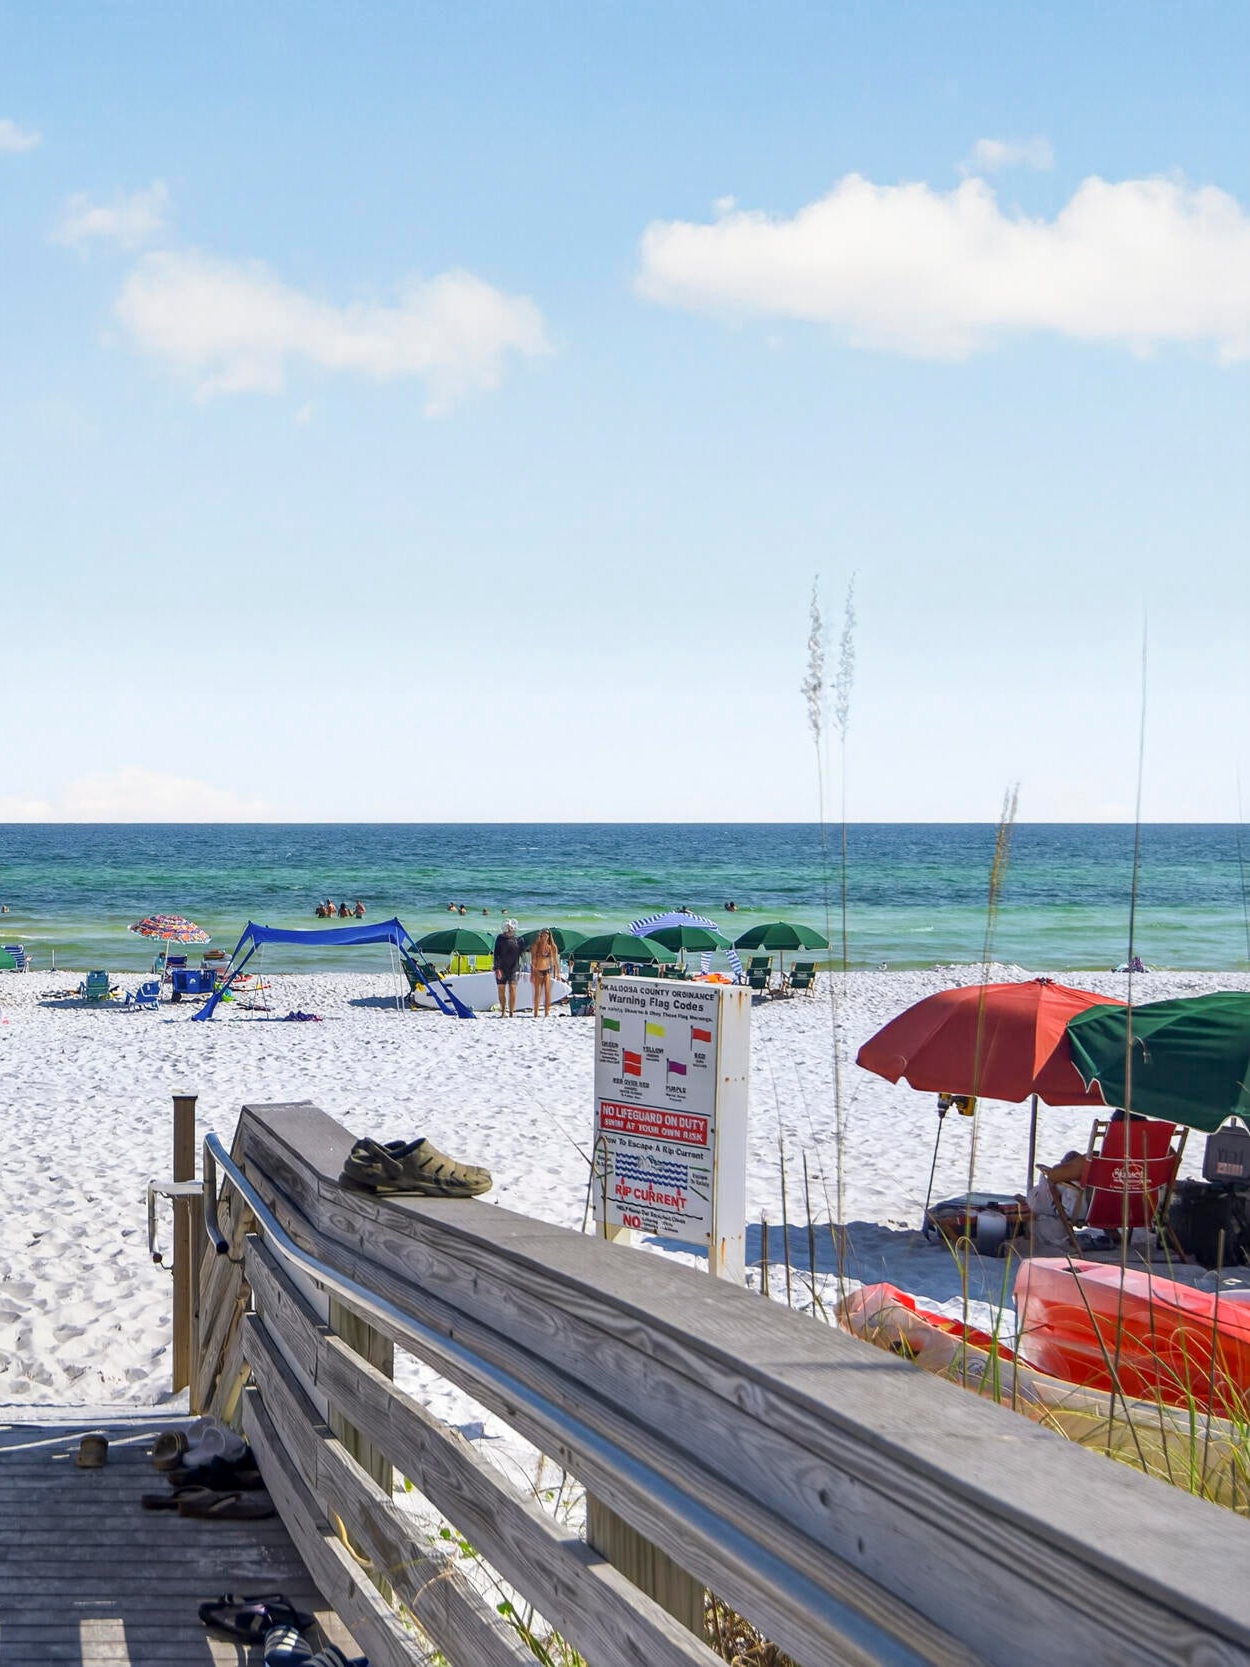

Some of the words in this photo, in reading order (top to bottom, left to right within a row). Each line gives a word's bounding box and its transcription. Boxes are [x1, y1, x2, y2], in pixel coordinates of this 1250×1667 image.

[600, 983, 638, 993] OKALOOSA
[640, 988, 670, 997] COUNTY
[672, 991, 715, 1001] ORDINANCE
[608, 993, 646, 1008] Warning
[649, 998, 670, 1011] Flag
[673, 1000, 704, 1012] Codes
[643, 1046, 664, 1055] YELLOW
[665, 1085, 687, 1094] PURPLE
[603, 1105, 615, 1117] NO
[616, 1107, 662, 1125] LIFEGUARD
[664, 1114, 678, 1126] ON
[679, 1116, 705, 1131] DUTY
[604, 1118, 624, 1129] SWIM
[625, 1121, 635, 1130] AT
[638, 1124, 659, 1135] YOUR
[661, 1128, 681, 1139] OWN
[683, 1131, 703, 1142] RISK
[618, 1138, 627, 1147] To
[627, 1140, 653, 1151] Escape
[655, 1144, 661, 1153] A
[662, 1146, 675, 1156] Rip
[676, 1148, 704, 1160] Current
[615, 1184, 632, 1197] RIP
[634, 1188, 687, 1209] CURRENT
[622, 1212, 641, 1228] NO
